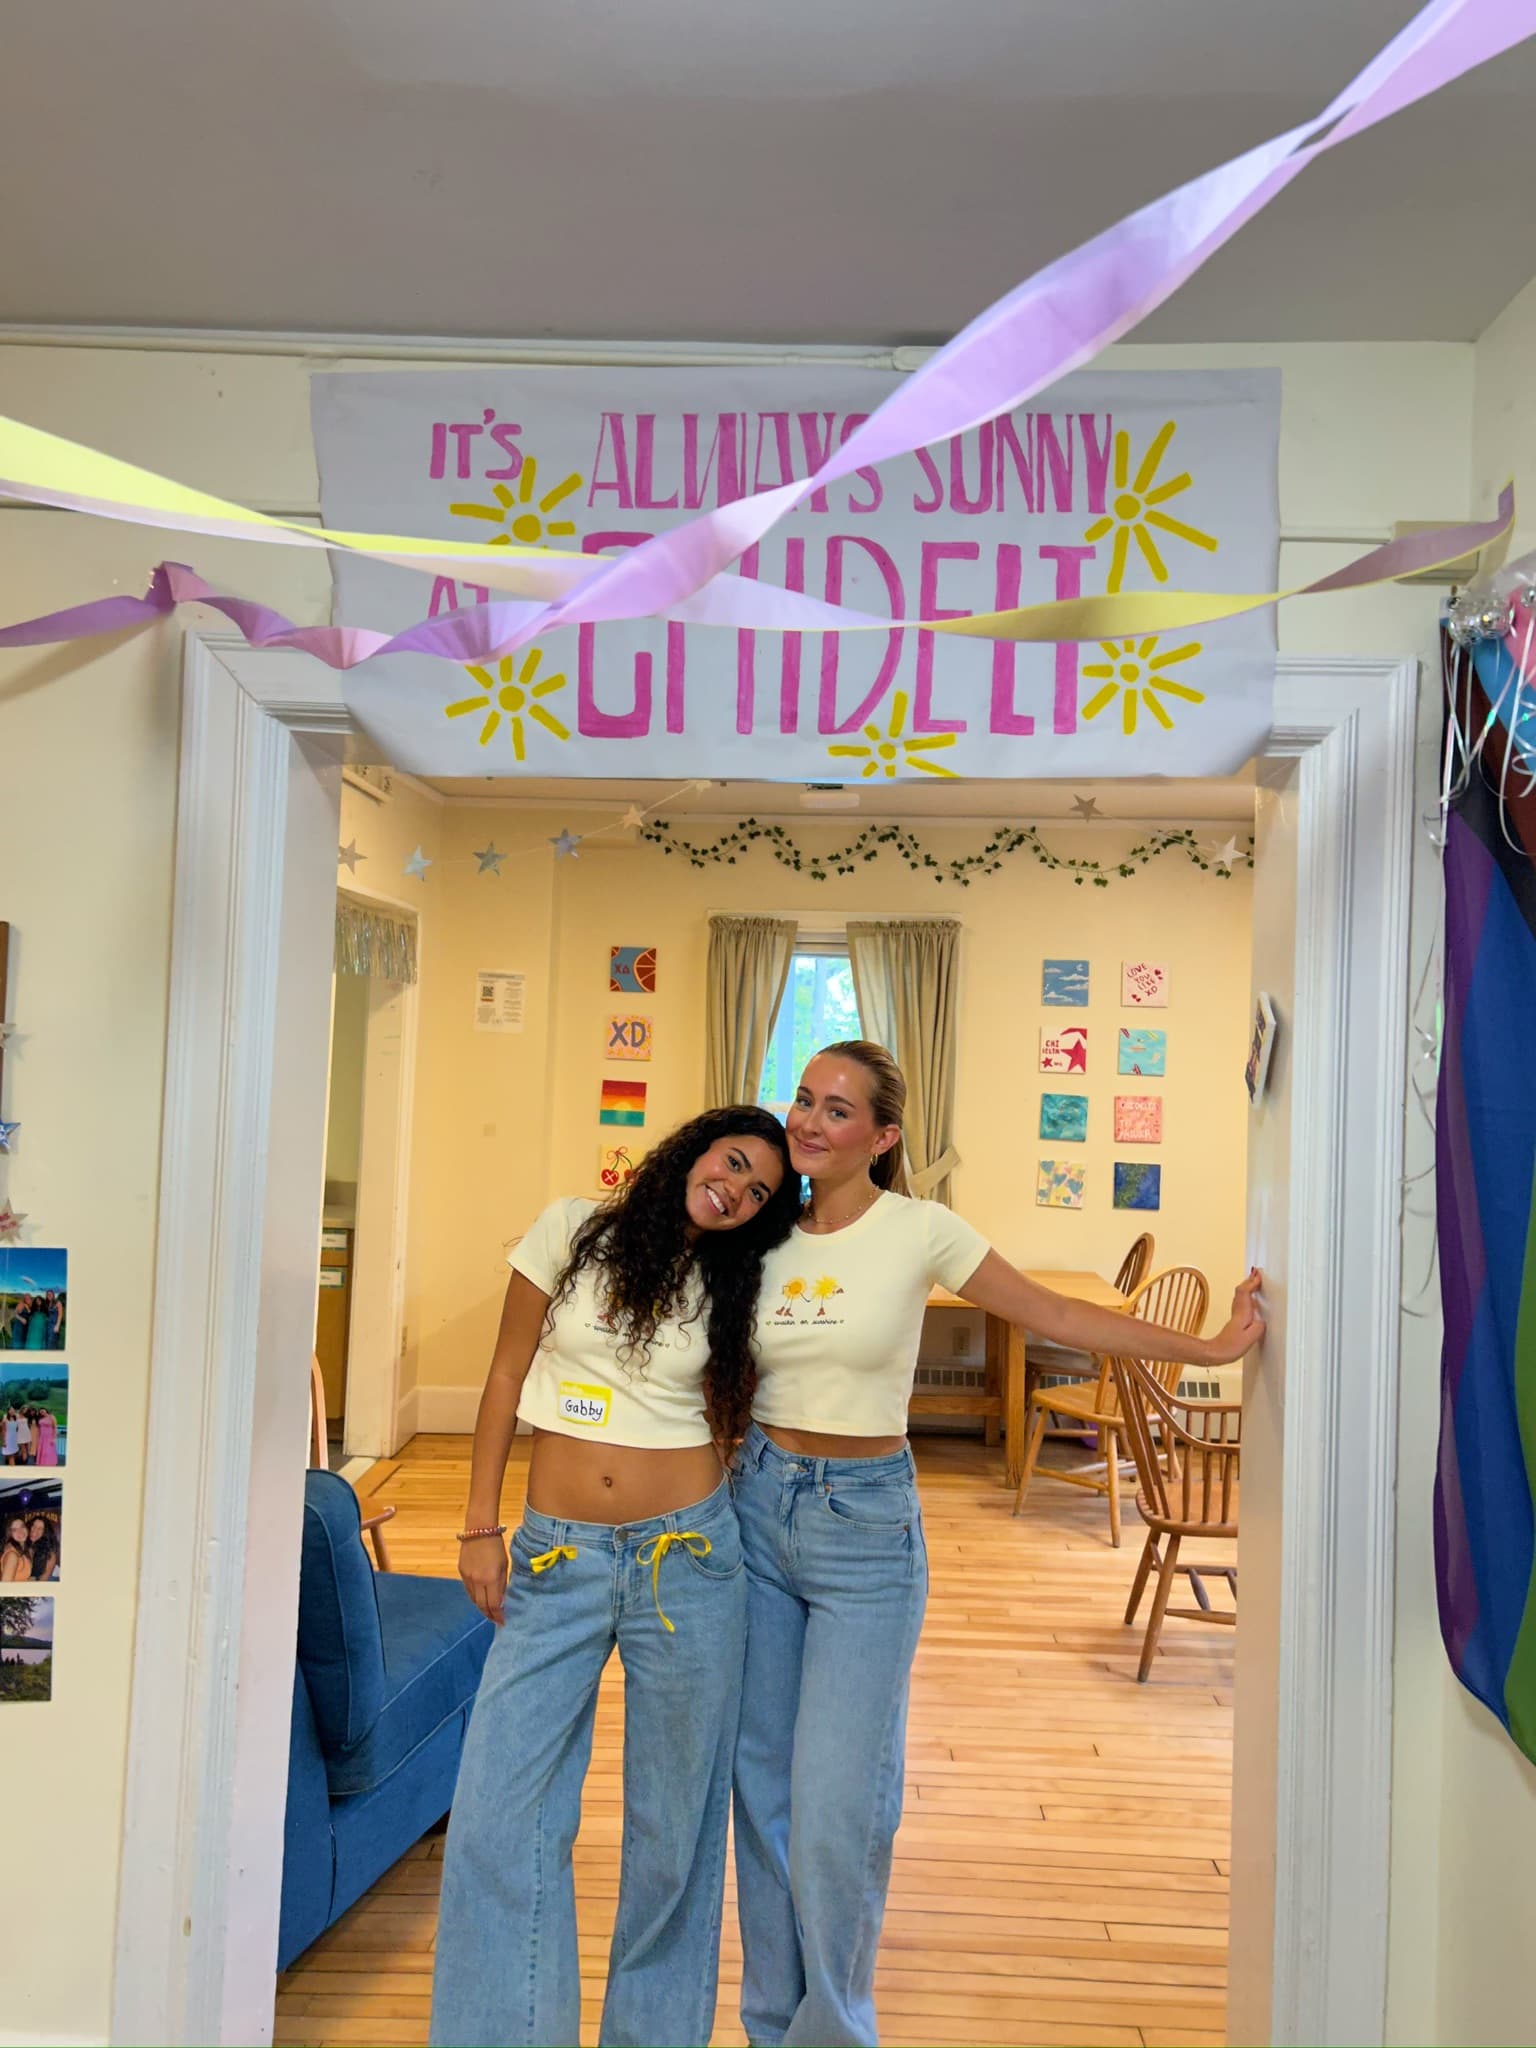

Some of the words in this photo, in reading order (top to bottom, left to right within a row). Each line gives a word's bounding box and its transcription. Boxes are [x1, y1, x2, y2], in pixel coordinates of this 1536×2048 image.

[430, 408, 523, 480] IT'S
[588, 412, 884, 514] ALWAYS
[914, 412, 1113, 515] SUNNY
[609, 1021, 646, 1048] XD
[1045, 1040, 1059, 1048] CHI
[565, 1399, 604, 1421] Gabby
